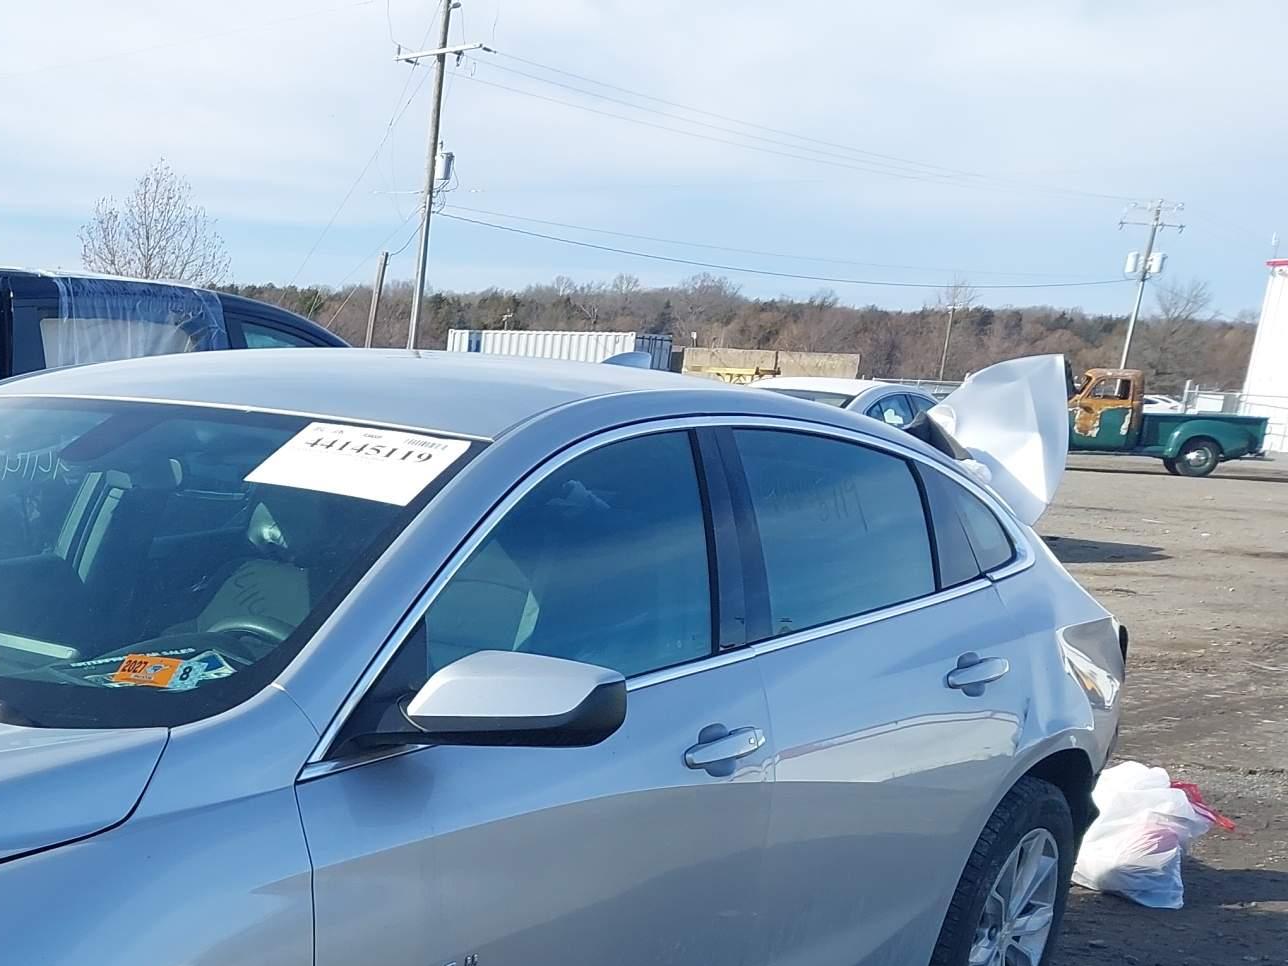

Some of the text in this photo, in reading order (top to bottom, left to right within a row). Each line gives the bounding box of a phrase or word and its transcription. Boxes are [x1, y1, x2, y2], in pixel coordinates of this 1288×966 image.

[304, 437, 433, 463] 44145119
[120, 659, 149, 673] 2027
[179, 665, 193, 681] 8
